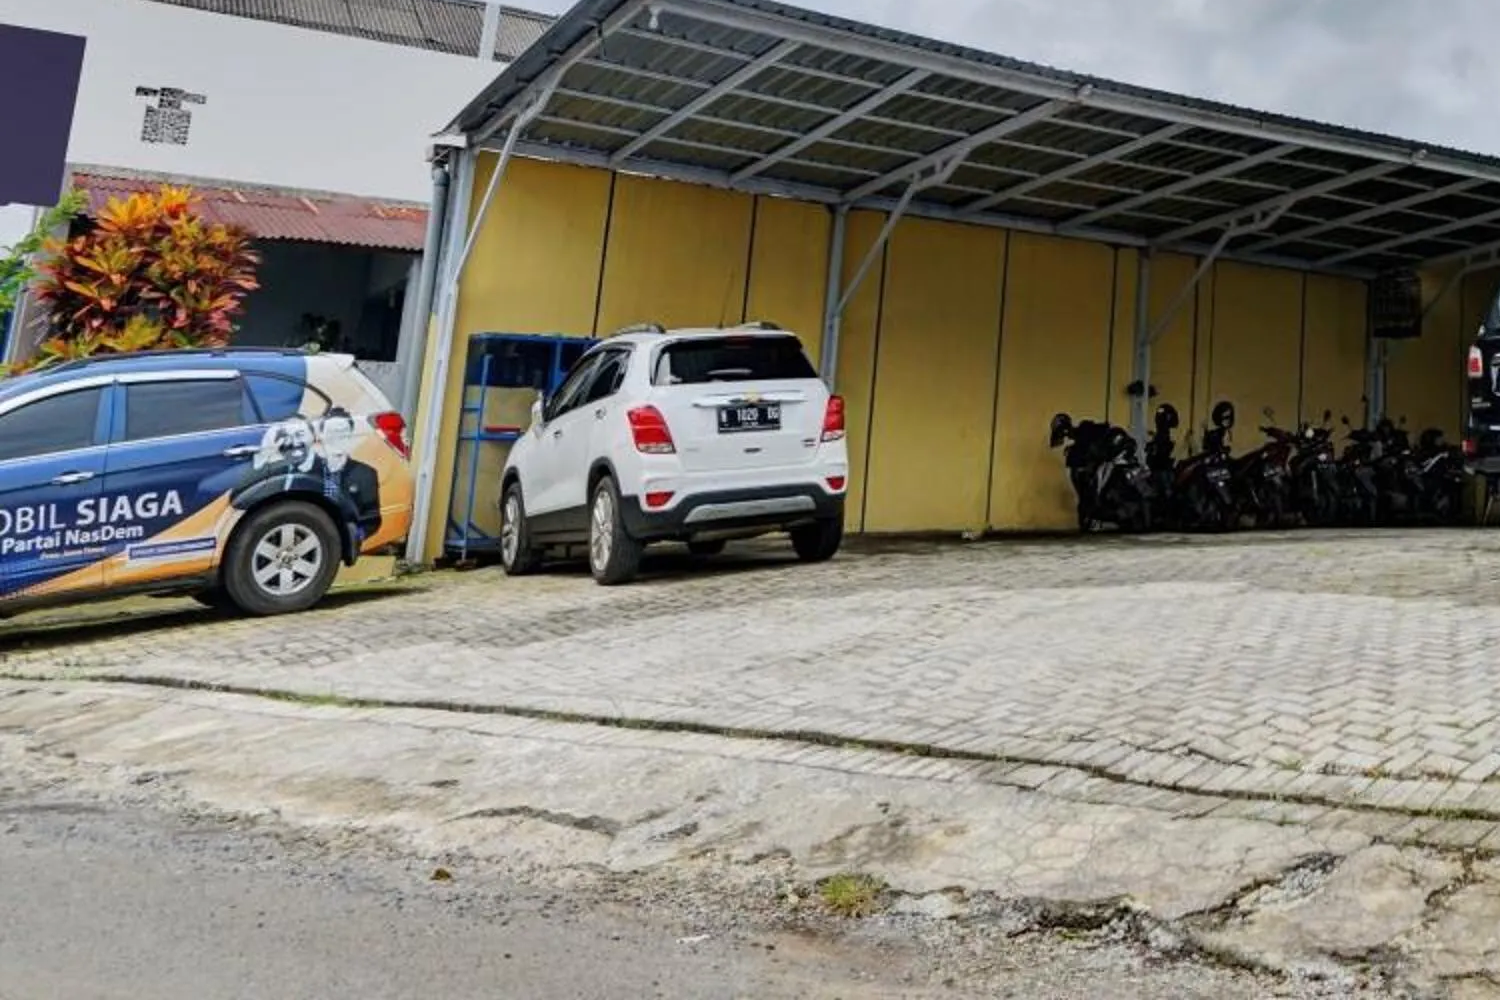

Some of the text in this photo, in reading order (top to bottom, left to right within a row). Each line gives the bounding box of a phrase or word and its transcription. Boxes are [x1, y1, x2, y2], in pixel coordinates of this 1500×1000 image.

[76, 490, 184, 526] SIAGA
[2, 532, 61, 555] Partai
[65, 524, 144, 546] NasDem
